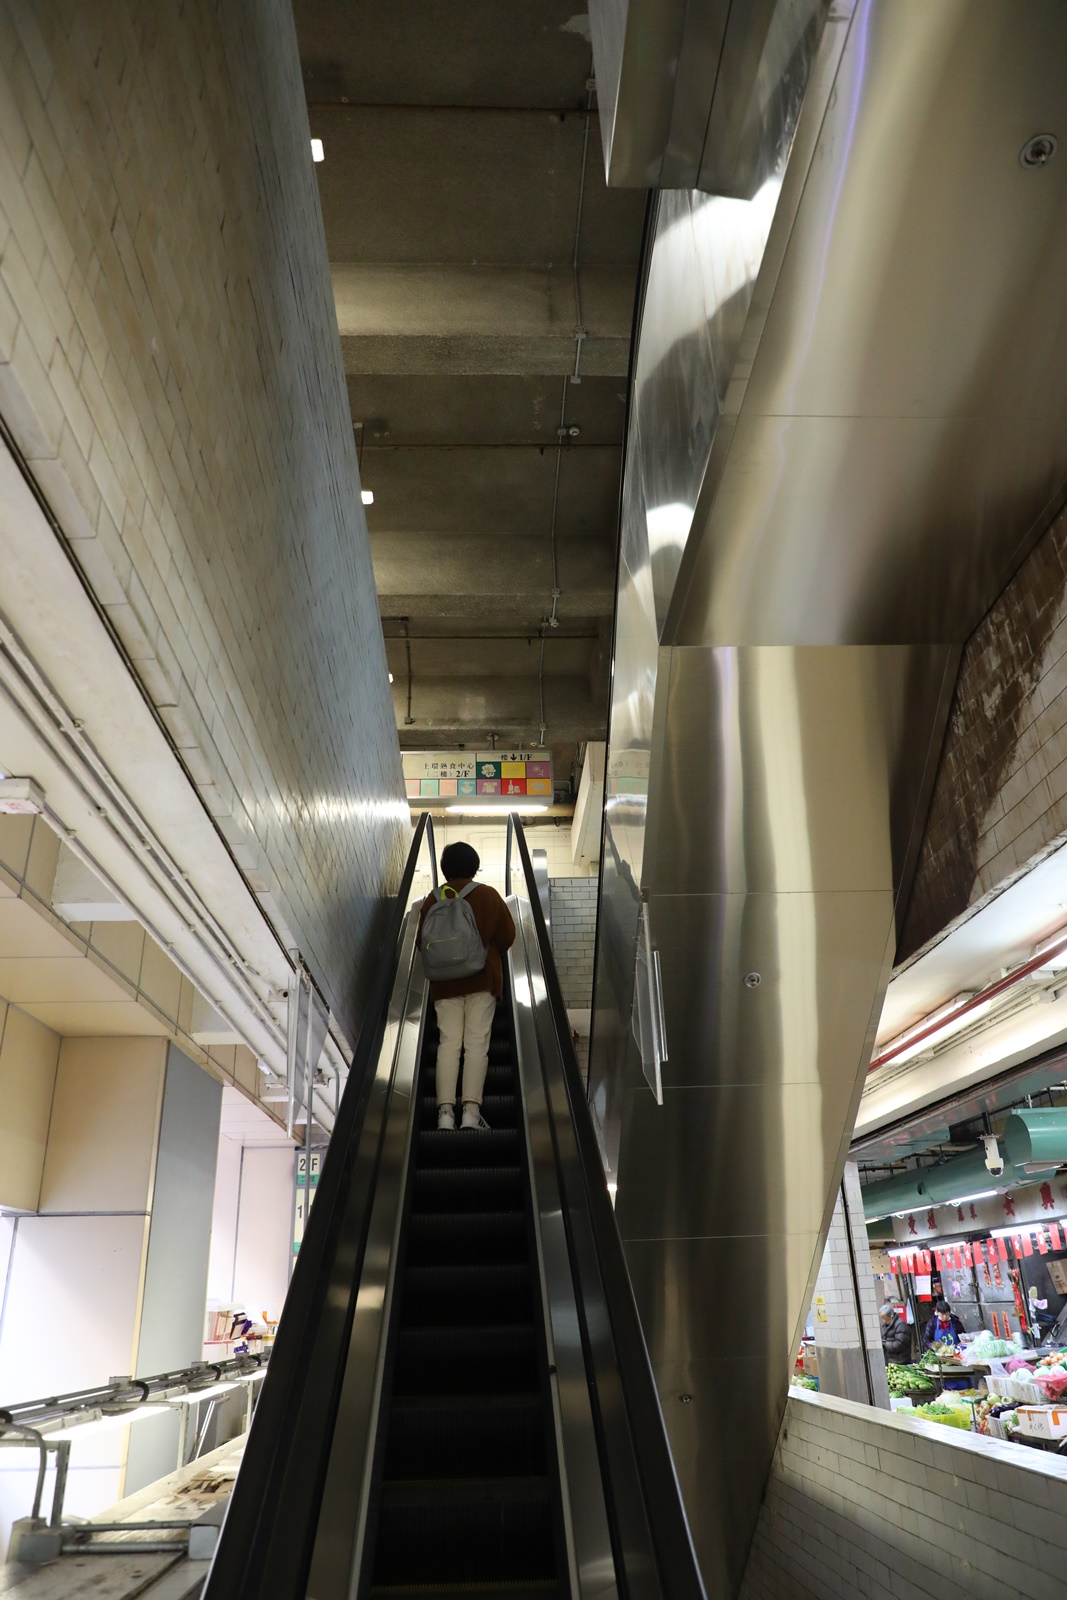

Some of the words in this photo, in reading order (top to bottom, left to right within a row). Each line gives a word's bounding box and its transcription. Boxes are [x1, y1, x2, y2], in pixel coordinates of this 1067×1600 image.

[424, 762, 474, 770] 上環熟食中心
[456, 770, 471, 778] 2/F
[299, 1157, 318, 1172] 2F
